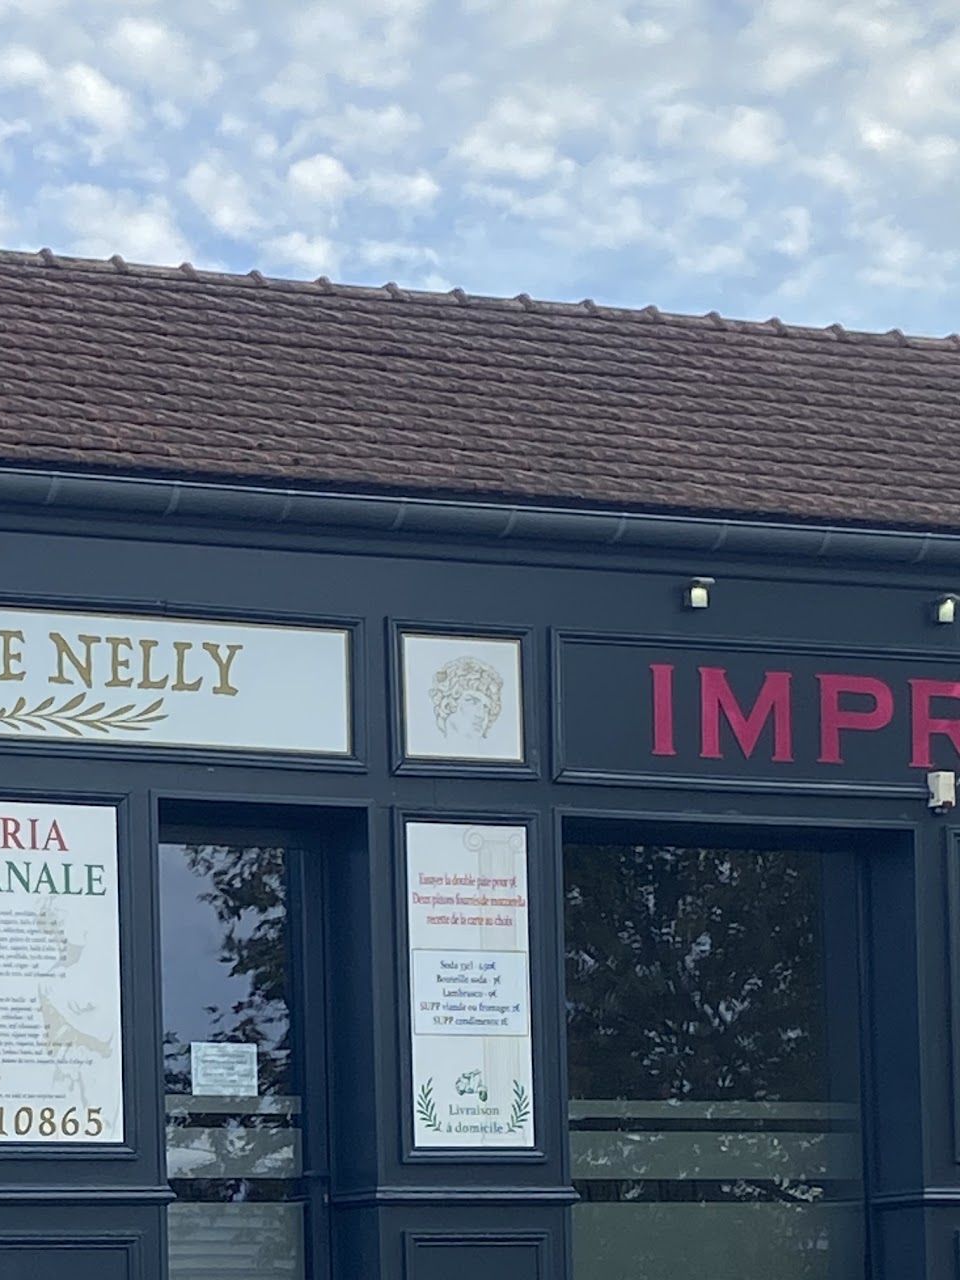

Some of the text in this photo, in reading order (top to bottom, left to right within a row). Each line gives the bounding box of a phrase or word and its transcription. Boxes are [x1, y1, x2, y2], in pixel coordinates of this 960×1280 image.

[48, 632, 244, 696] NELLY
[494, 913, 513, 926] choix
[440, 960, 458, 970] Soda
[471, 975, 487, 984] soda
[468, 1003, 477, 1011] ou
[448, 1104, 500, 1116] Livraison
[446, 1120, 504, 1134] à domicile
